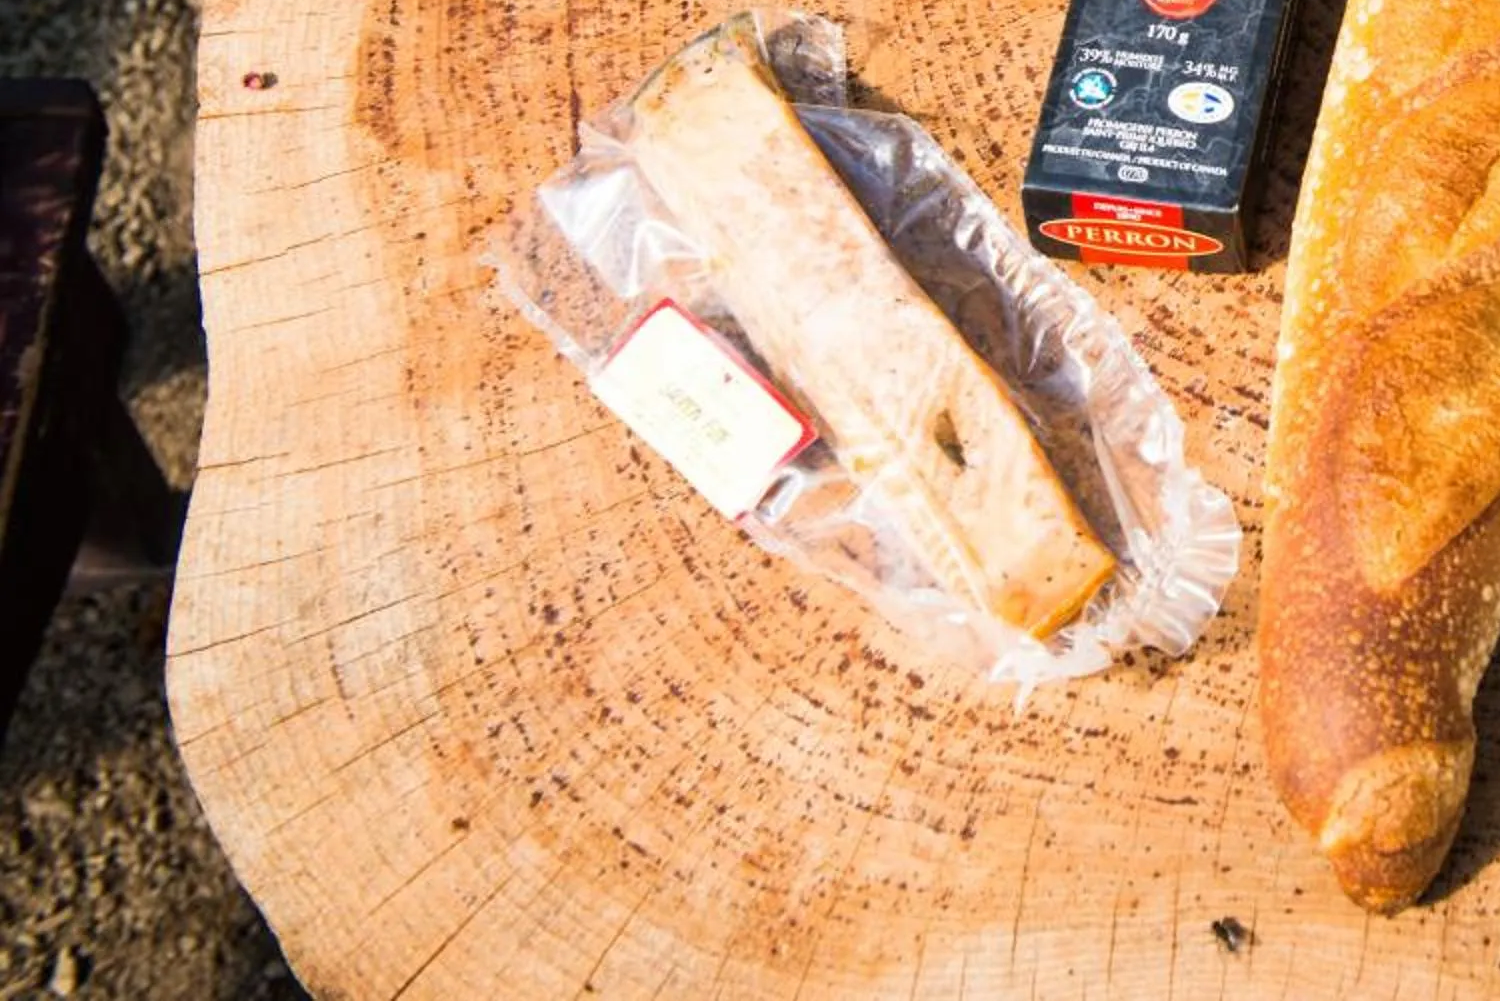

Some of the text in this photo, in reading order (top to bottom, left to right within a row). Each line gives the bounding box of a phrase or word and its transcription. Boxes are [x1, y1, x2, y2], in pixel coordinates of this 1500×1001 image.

[1147, 24, 1190, 46] 170 g
[1067, 225, 1196, 251] PERRON
